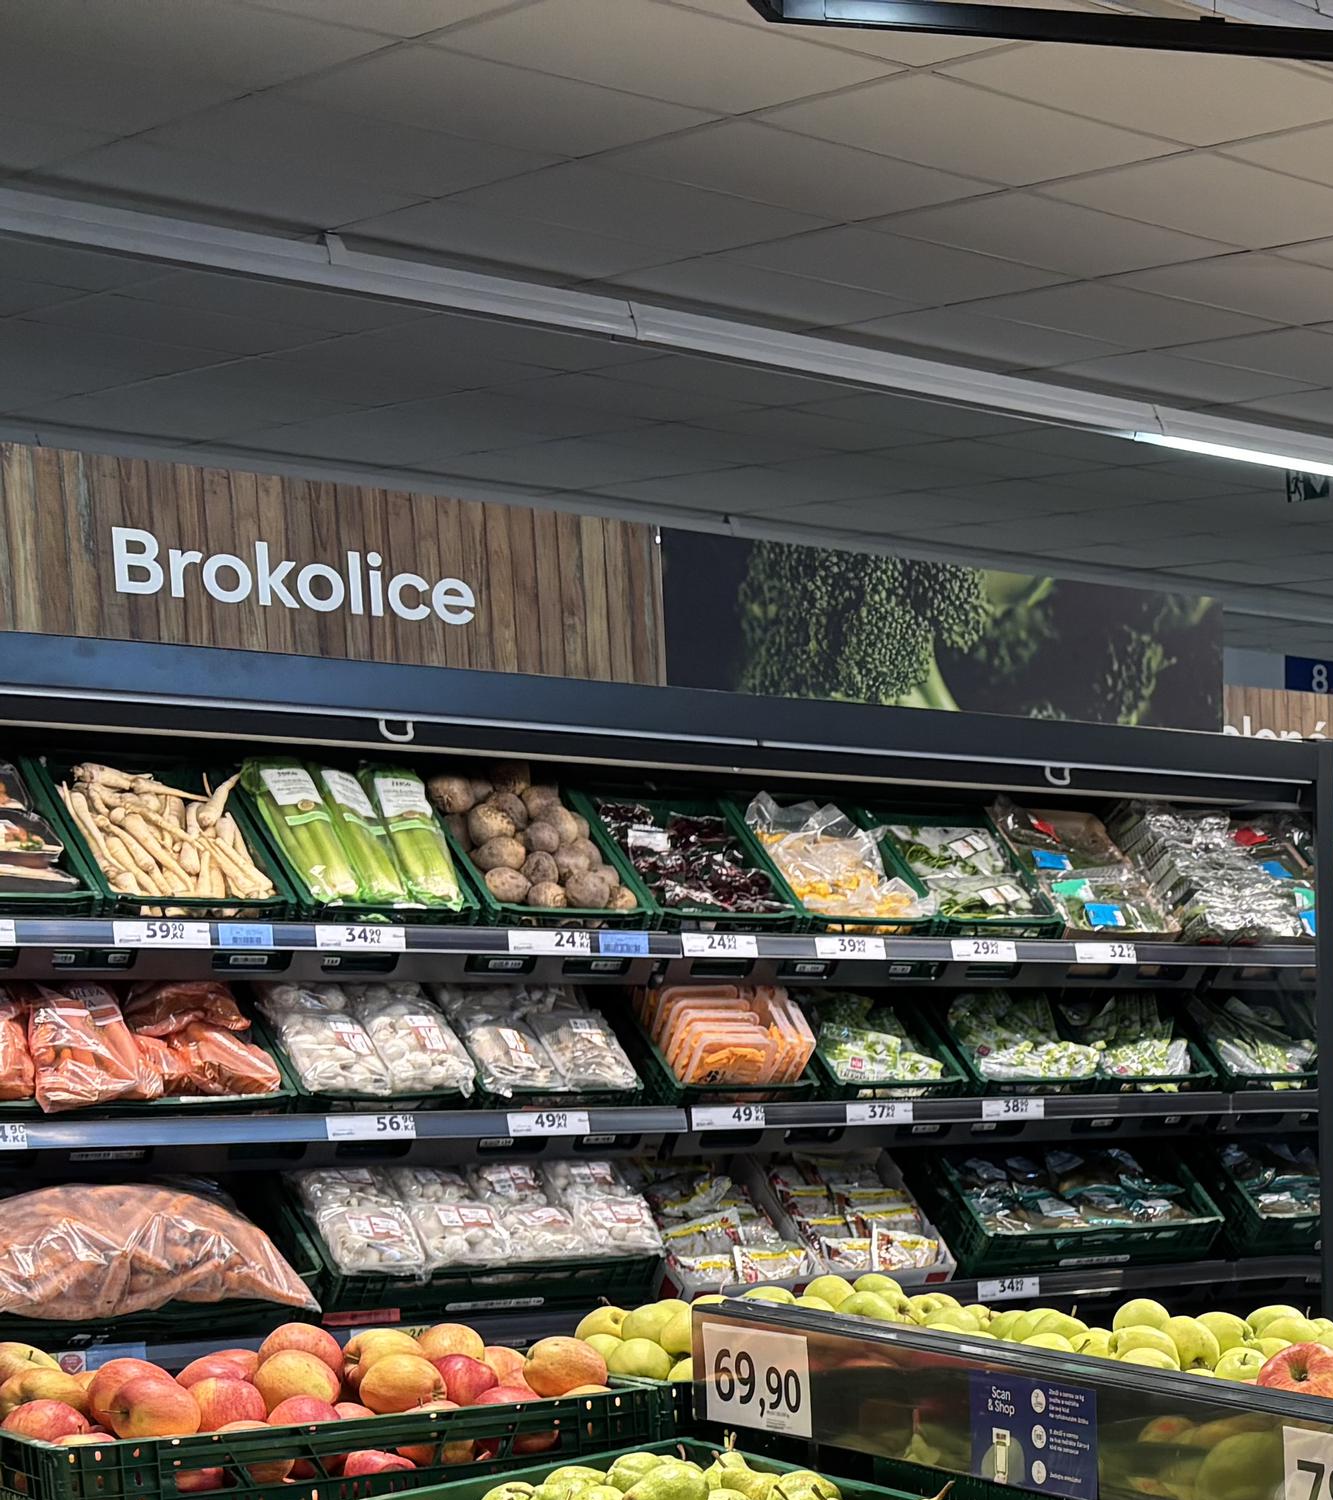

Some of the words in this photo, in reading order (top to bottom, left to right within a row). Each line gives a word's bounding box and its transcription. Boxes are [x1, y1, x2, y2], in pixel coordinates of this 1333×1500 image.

[111, 526, 476, 626] Brokolice
[145, 922, 169, 939] 59
[345, 927, 366, 943] 34
[553, 932, 577, 948] 24
[972, 940, 990, 955] 29
[1108, 944, 1127, 957] 32
[868, 1104, 886, 1119] 37
[1002, 1098, 1020, 1113] 38
[375, 1115, 401, 1132] 56
[533, 1112, 556, 1129] 49
[713, 1348, 801, 1419] 69,90
[991, 1385, 1011, 1400] Scan
[988, 1398, 993, 1411] &
[995, 1400, 1015, 1417] Shop
